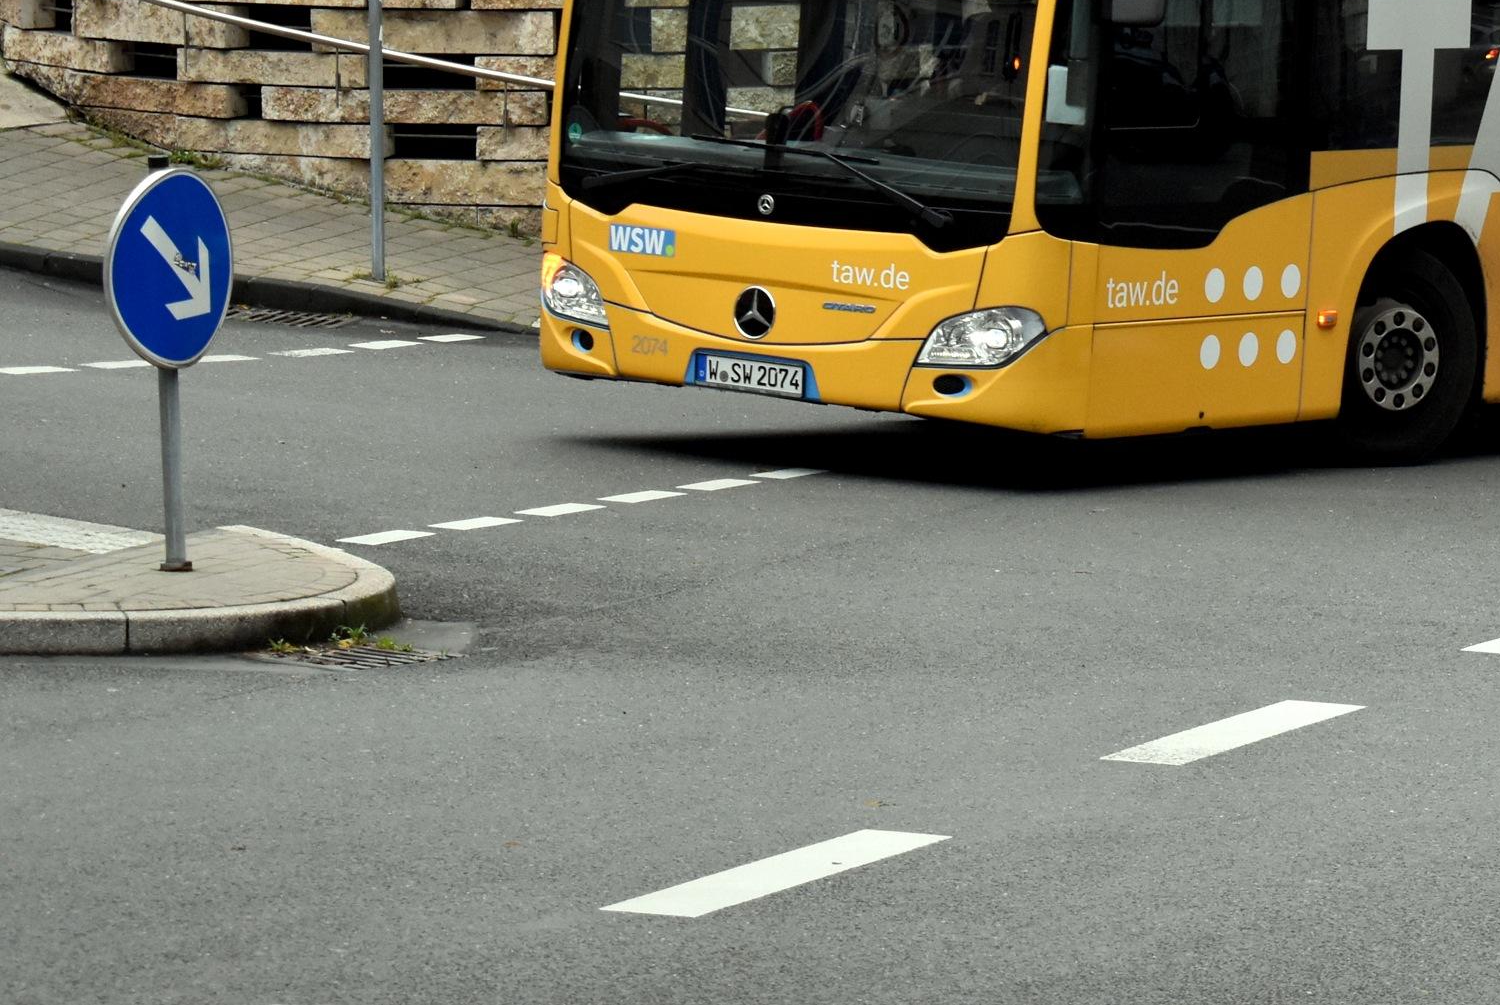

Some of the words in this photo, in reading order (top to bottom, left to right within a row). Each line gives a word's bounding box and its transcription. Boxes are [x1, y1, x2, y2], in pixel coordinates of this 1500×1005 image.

[831, 260, 910, 290] taw.de
[1106, 270, 1179, 309] taw.de
[631, 334, 668, 356] 2074
[757, 367, 799, 390] 2074
